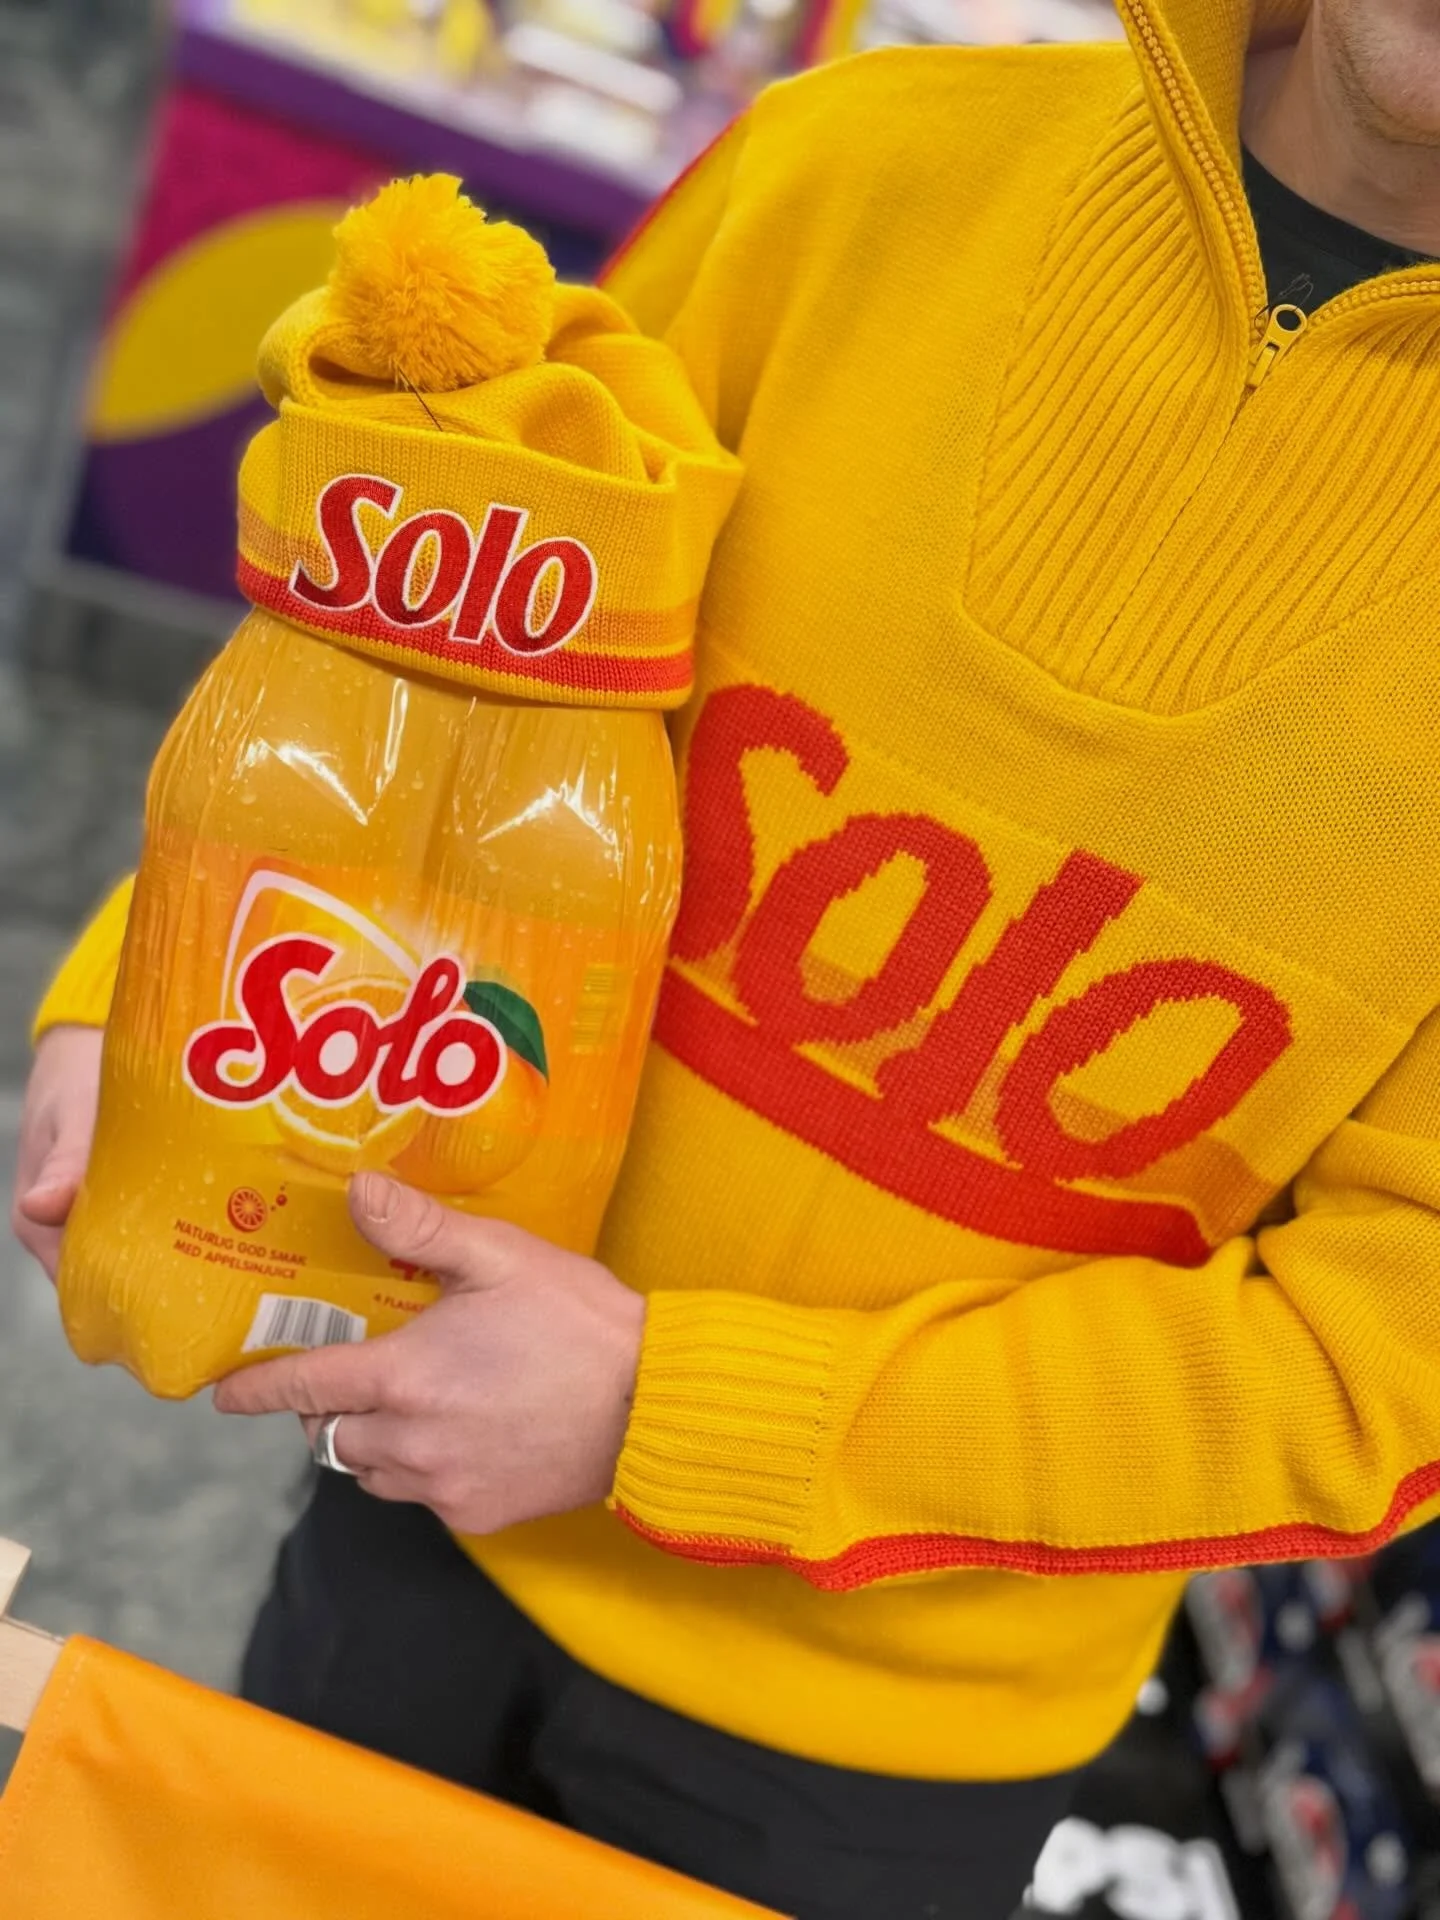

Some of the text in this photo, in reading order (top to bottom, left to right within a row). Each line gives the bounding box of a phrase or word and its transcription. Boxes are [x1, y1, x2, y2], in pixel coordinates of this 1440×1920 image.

[290, 473, 598, 656] Solo
[668, 684, 1293, 1180] Solo
[184, 932, 506, 1117] Solo
[174, 1239, 202, 1257] MED
[175, 1219, 307, 1266] NATURLIG GOD SMAK
